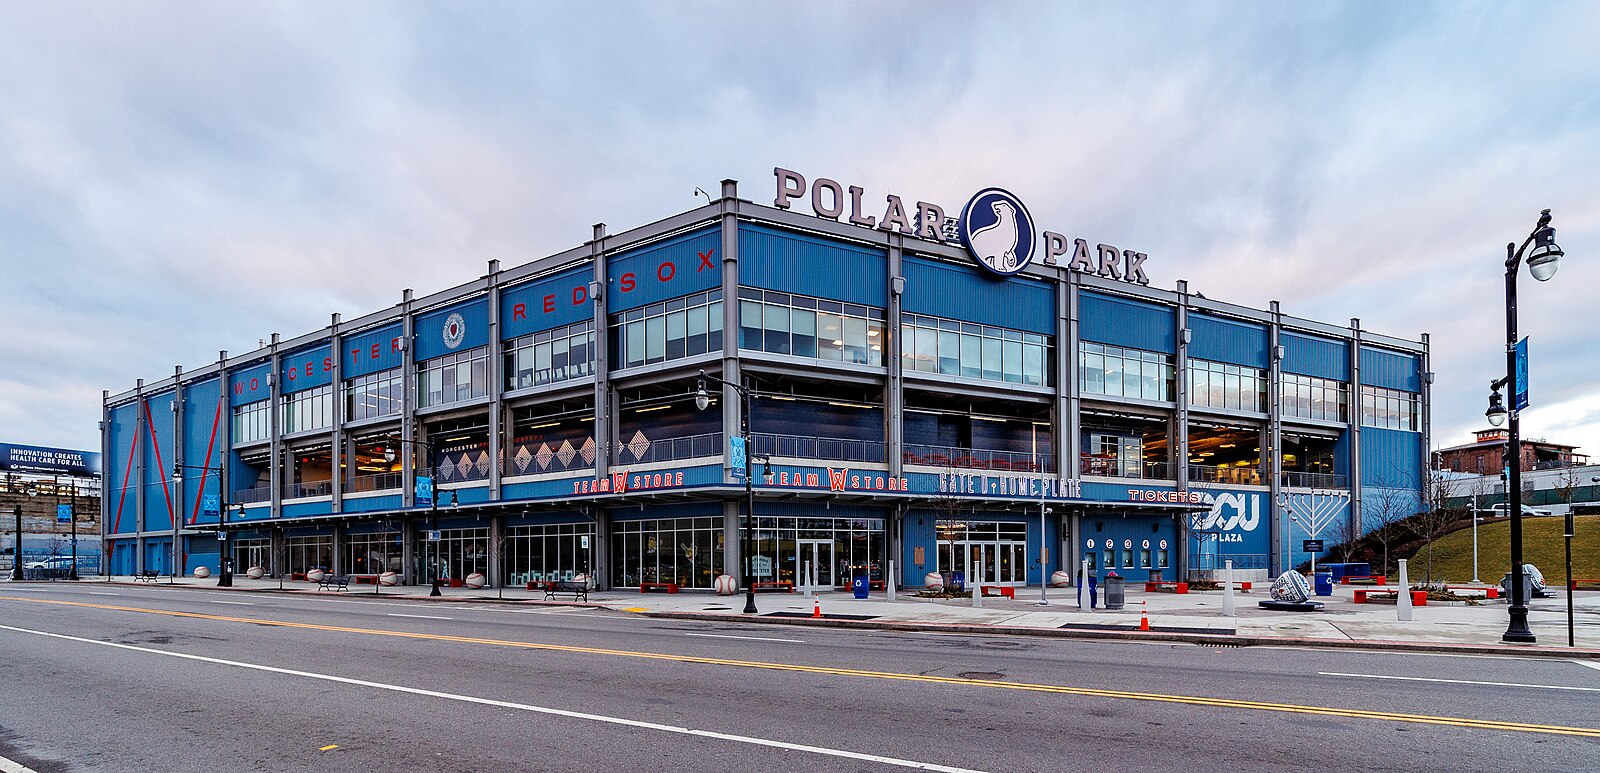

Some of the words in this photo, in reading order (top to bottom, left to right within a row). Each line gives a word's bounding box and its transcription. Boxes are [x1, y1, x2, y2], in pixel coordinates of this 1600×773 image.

[774, 167, 946, 242] POLAR
[1043, 230, 1149, 285] PARK
[234, 338, 400, 395] WOCESTER
[513, 286, 587, 322] RED
[620, 248, 714, 293] SOX
[10, 448, 53, 458] INNOVATION
[54, 452, 82, 461] CREATES
[441, 443, 478, 453] WORCESTER
[10, 455, 37, 463] HEALTH
[38, 457, 56, 465] CARE
[57, 458, 70, 466] FOR
[573, 478, 610, 494] TEAM
[633, 471, 684, 489] STORE
[851, 475, 908, 491] STORE
[939, 471, 975, 494] GATE
[1000, 475, 1036, 496] HOME
[1042, 477, 1081, 498] PLATE
[1128, 489, 1201, 504] TICKETS
[1211, 533, 1243, 543] PLAZA
